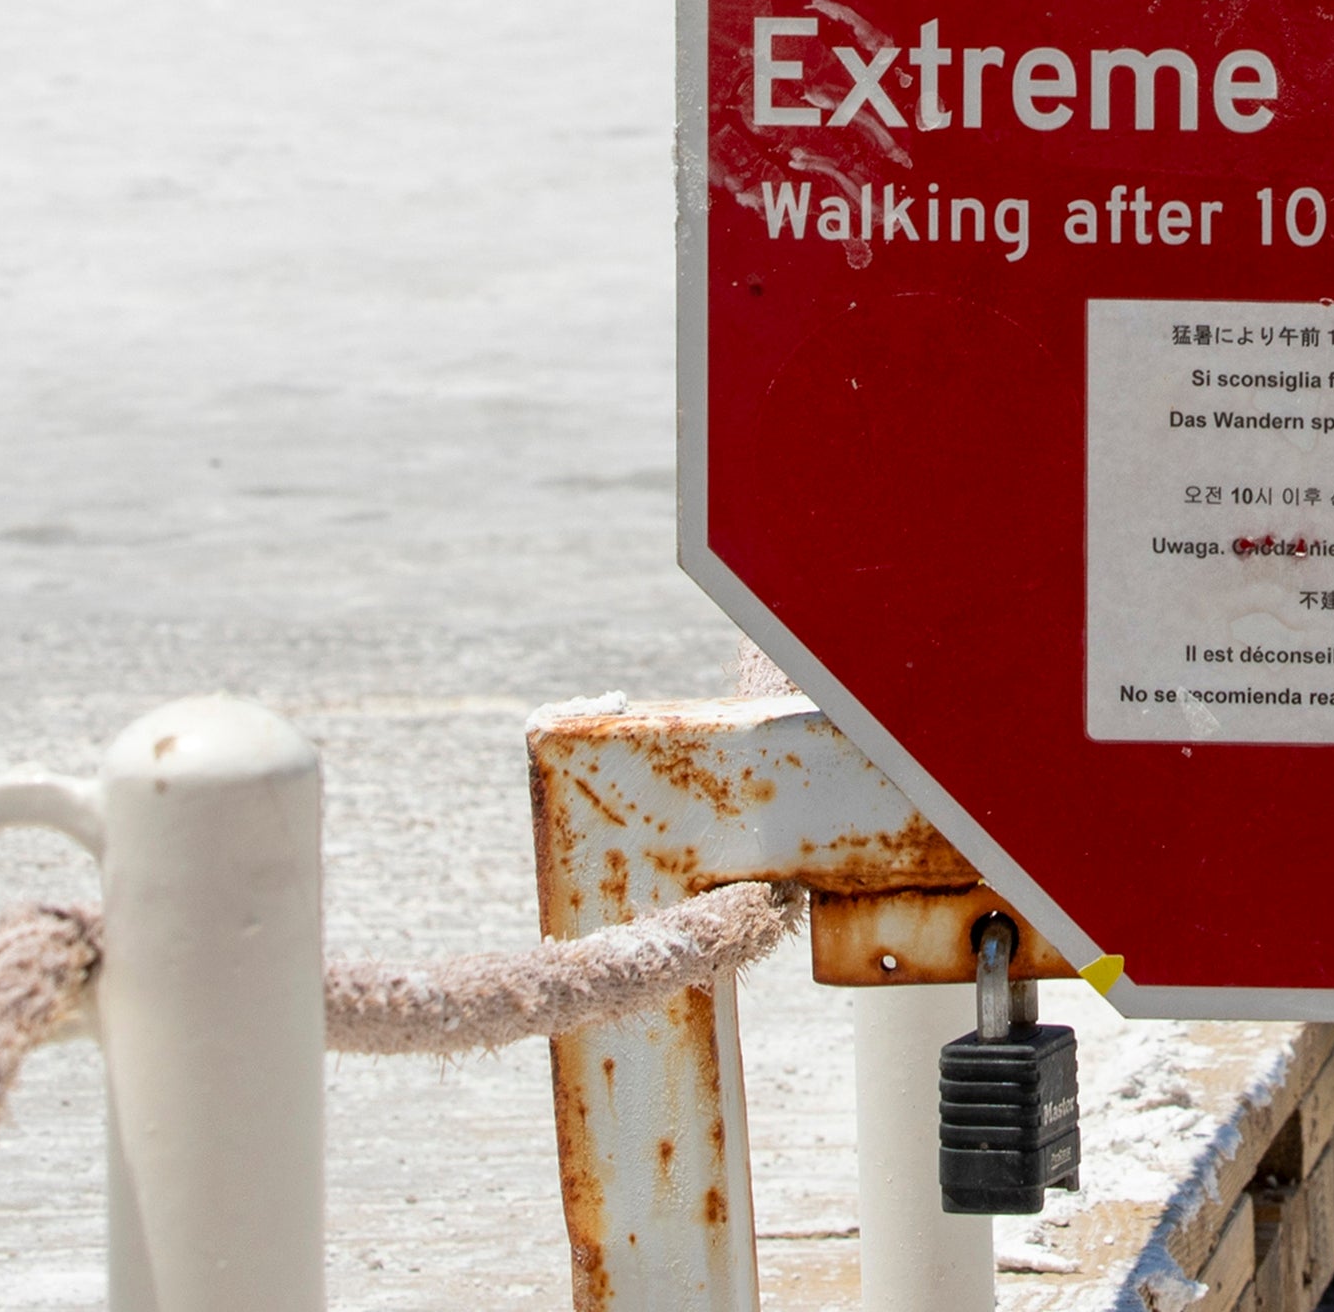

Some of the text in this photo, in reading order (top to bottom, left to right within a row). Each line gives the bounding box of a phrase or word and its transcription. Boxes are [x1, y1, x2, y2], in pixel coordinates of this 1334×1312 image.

[753, 16, 1279, 134] Extreme
[761, 181, 1029, 262] Walking
[1065, 186, 1222, 244] after
[1257, 188, 1326, 246] 10
[1191, 369, 1210, 386] Si
[1217, 370, 1321, 392] sconsiglia
[1169, 410, 1206, 428] Das
[1213, 411, 1303, 429] Wandern
[1184, 485, 1221, 504] 오전
[1231, 487, 1271, 504] 10시
[1282, 487, 1321, 505] 이후
[1152, 537, 1224, 558] Uwaga.
[1186, 644, 1196, 661] Il
[1203, 646, 1233, 662] est
[1120, 684, 1147, 702] No
[1154, 689, 1176, 703] se
[1184, 688, 1302, 706] ecomienda
